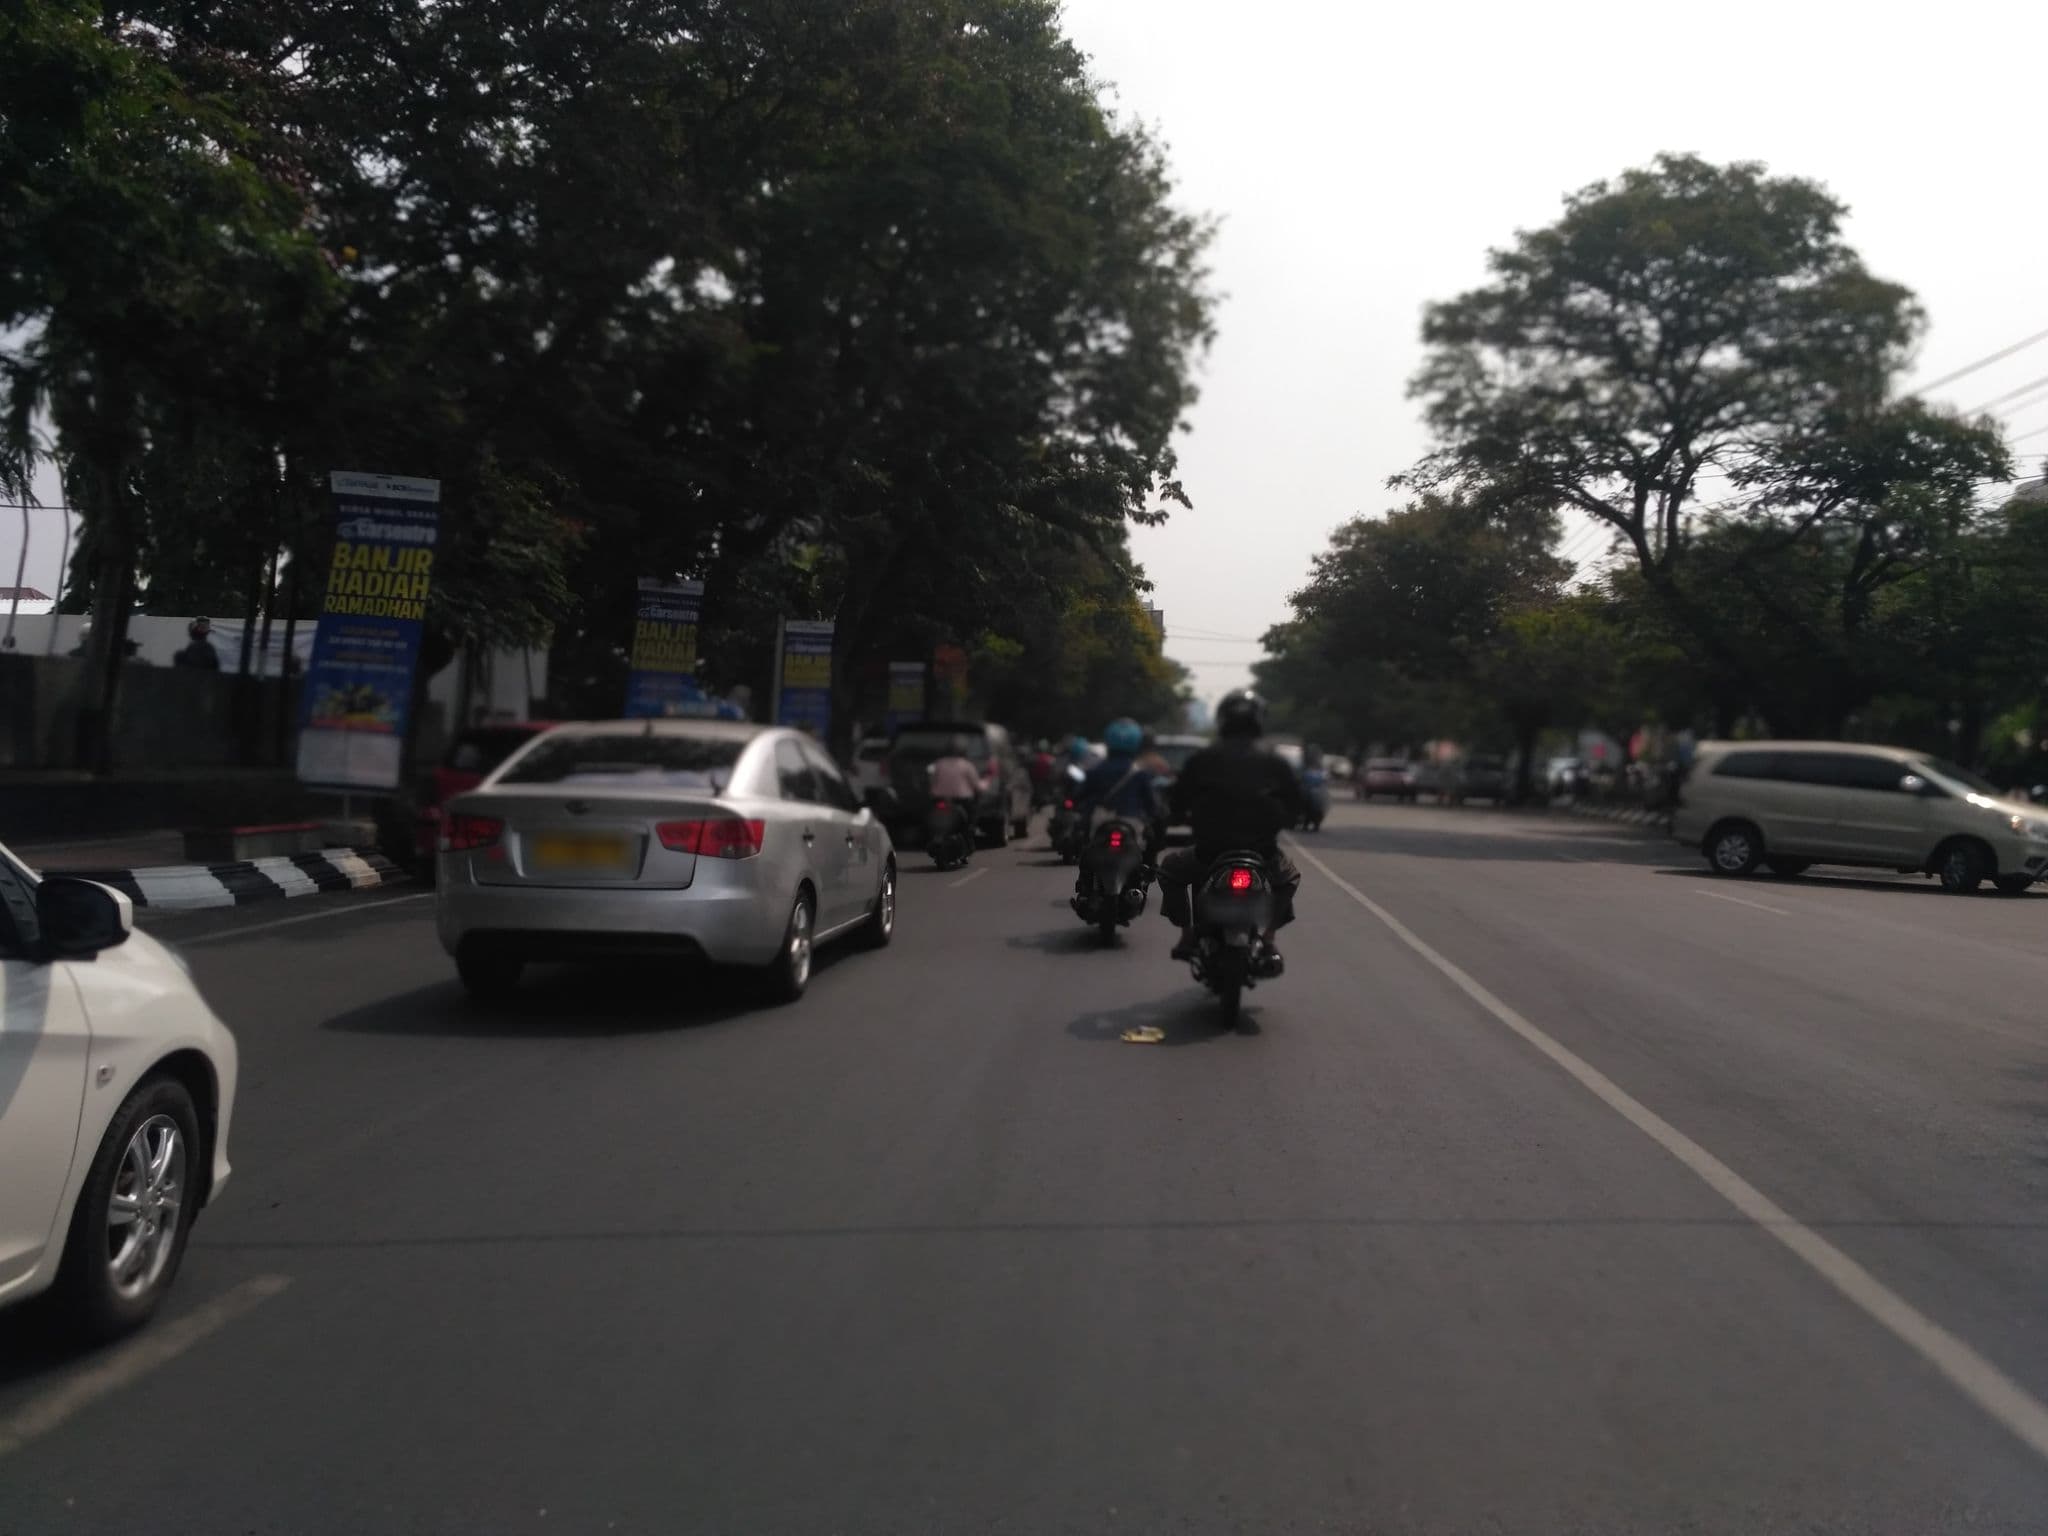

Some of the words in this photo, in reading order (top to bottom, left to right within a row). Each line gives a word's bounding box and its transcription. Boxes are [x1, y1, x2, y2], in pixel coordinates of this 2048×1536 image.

[333, 543, 434, 575] BANJIR
[328, 569, 430, 600] HADIAH
[324, 594, 425, 619] RAMADHAN
